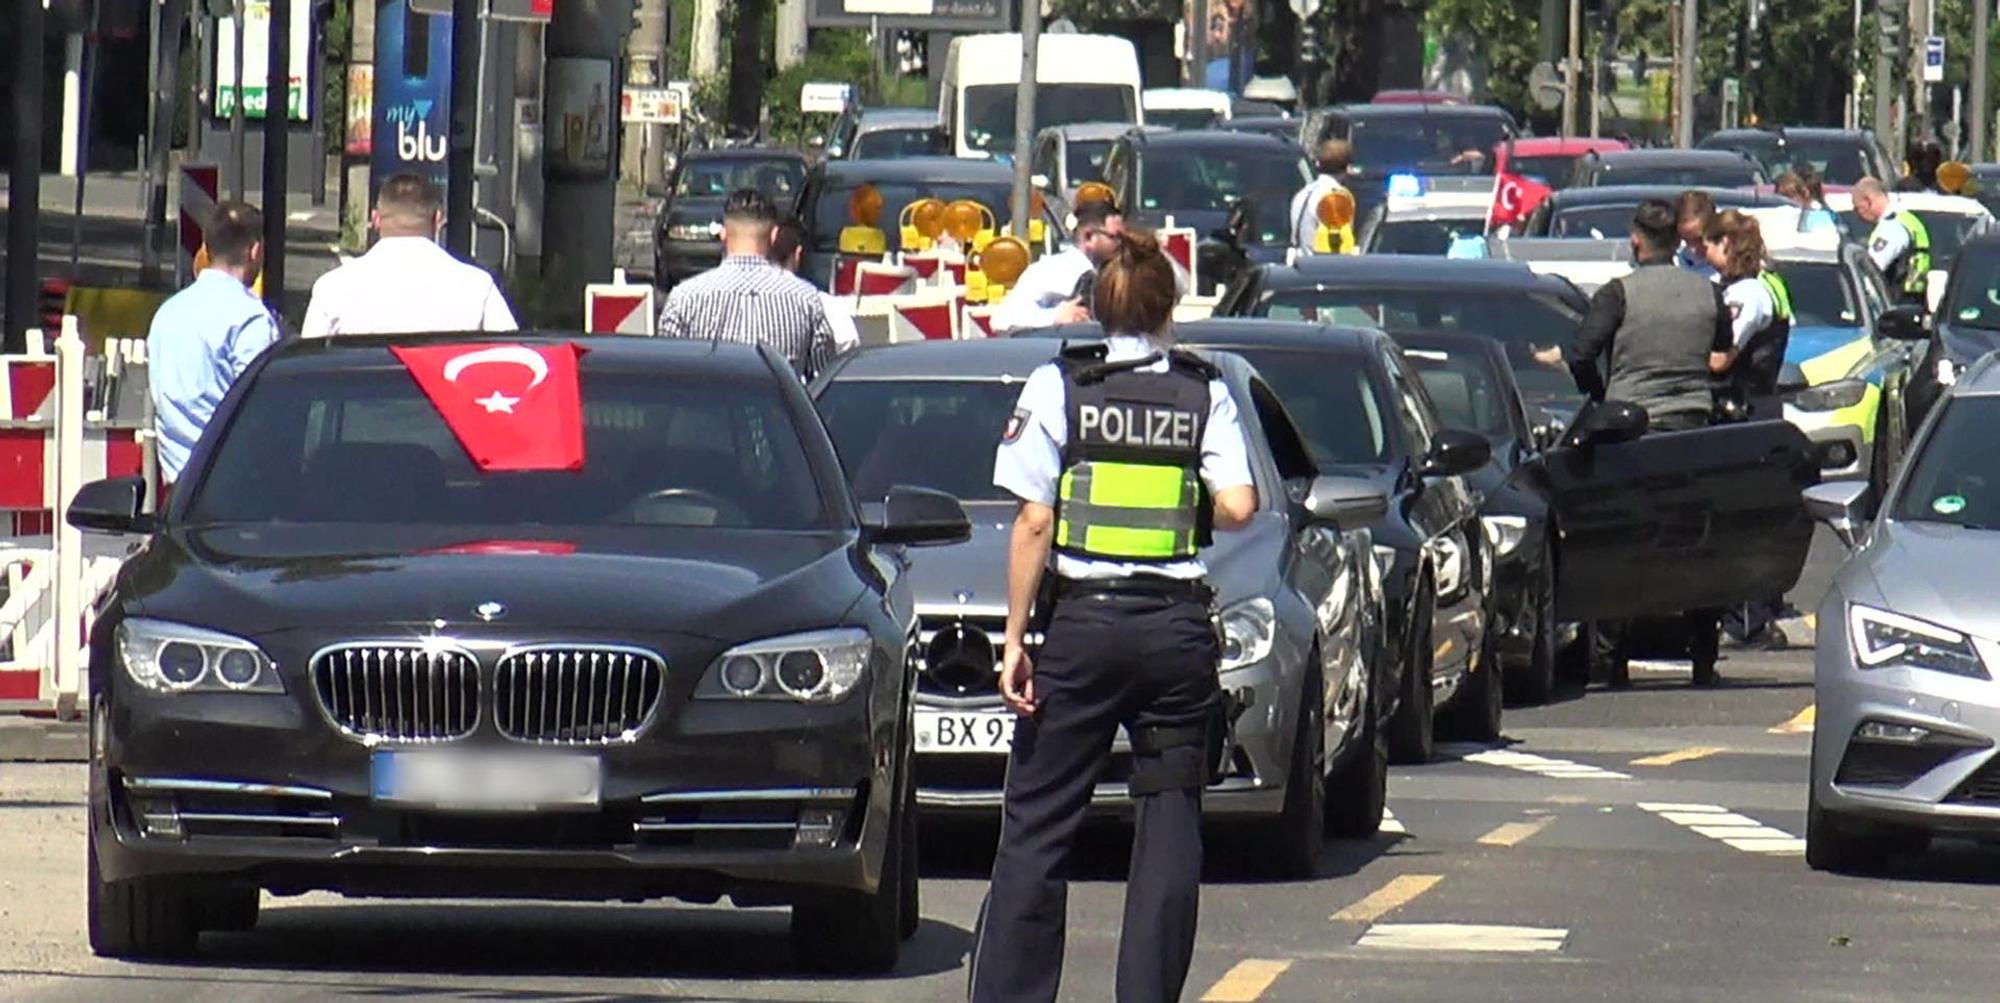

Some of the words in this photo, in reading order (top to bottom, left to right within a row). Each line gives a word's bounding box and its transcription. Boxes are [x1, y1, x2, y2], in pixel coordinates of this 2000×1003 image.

[386, 104, 416, 131] my
[398, 119, 447, 161] blu
[1079, 404, 1199, 447] POLIZEI
[937, 716, 977, 746] BX
